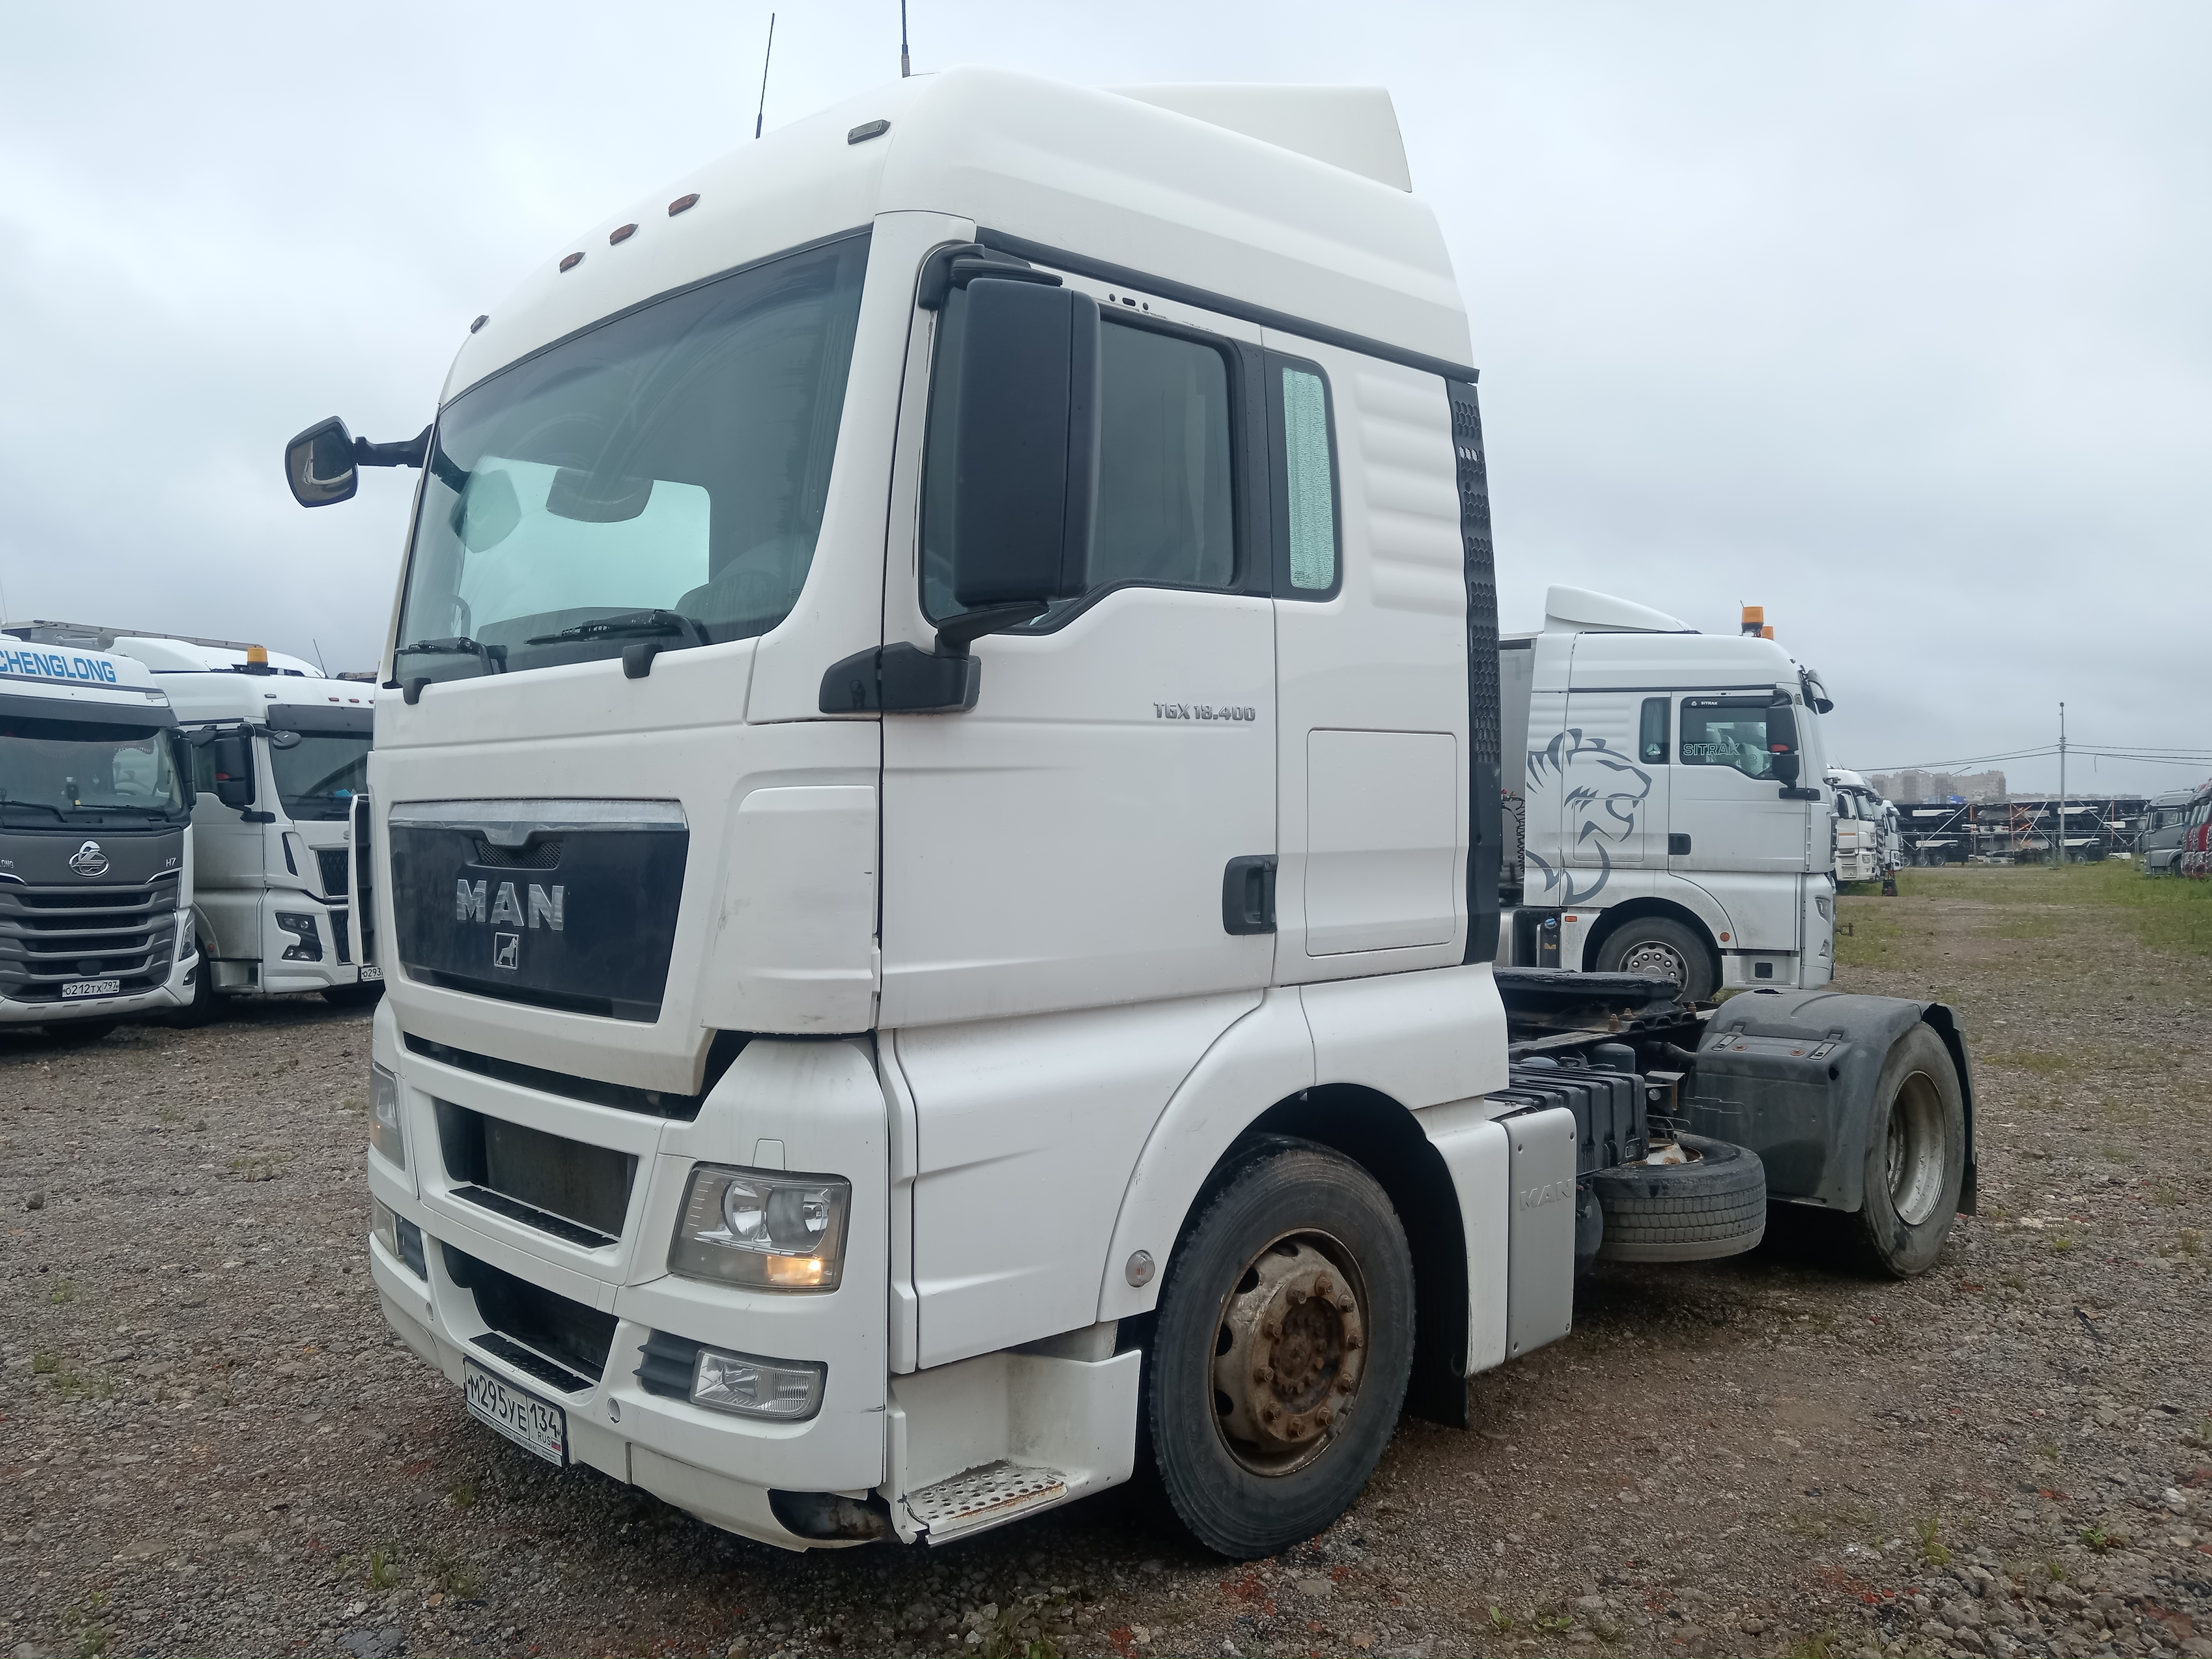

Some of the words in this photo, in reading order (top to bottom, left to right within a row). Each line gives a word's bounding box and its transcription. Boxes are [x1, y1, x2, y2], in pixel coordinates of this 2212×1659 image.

[1153, 702, 1190, 719] TGX
[1194, 704, 1256, 721] 18.400
[1683, 743, 1740, 756] SITRAK
[0, 859, 14, 868] ONG
[166, 857, 176, 867] H7
[457, 879, 564, 931] MAN
[364, 968, 383, 977] О293
[1520, 1179, 1573, 1211] MAN
[530, 1403, 557, 1438] 134
[538, 1431, 551, 1446] RUS
